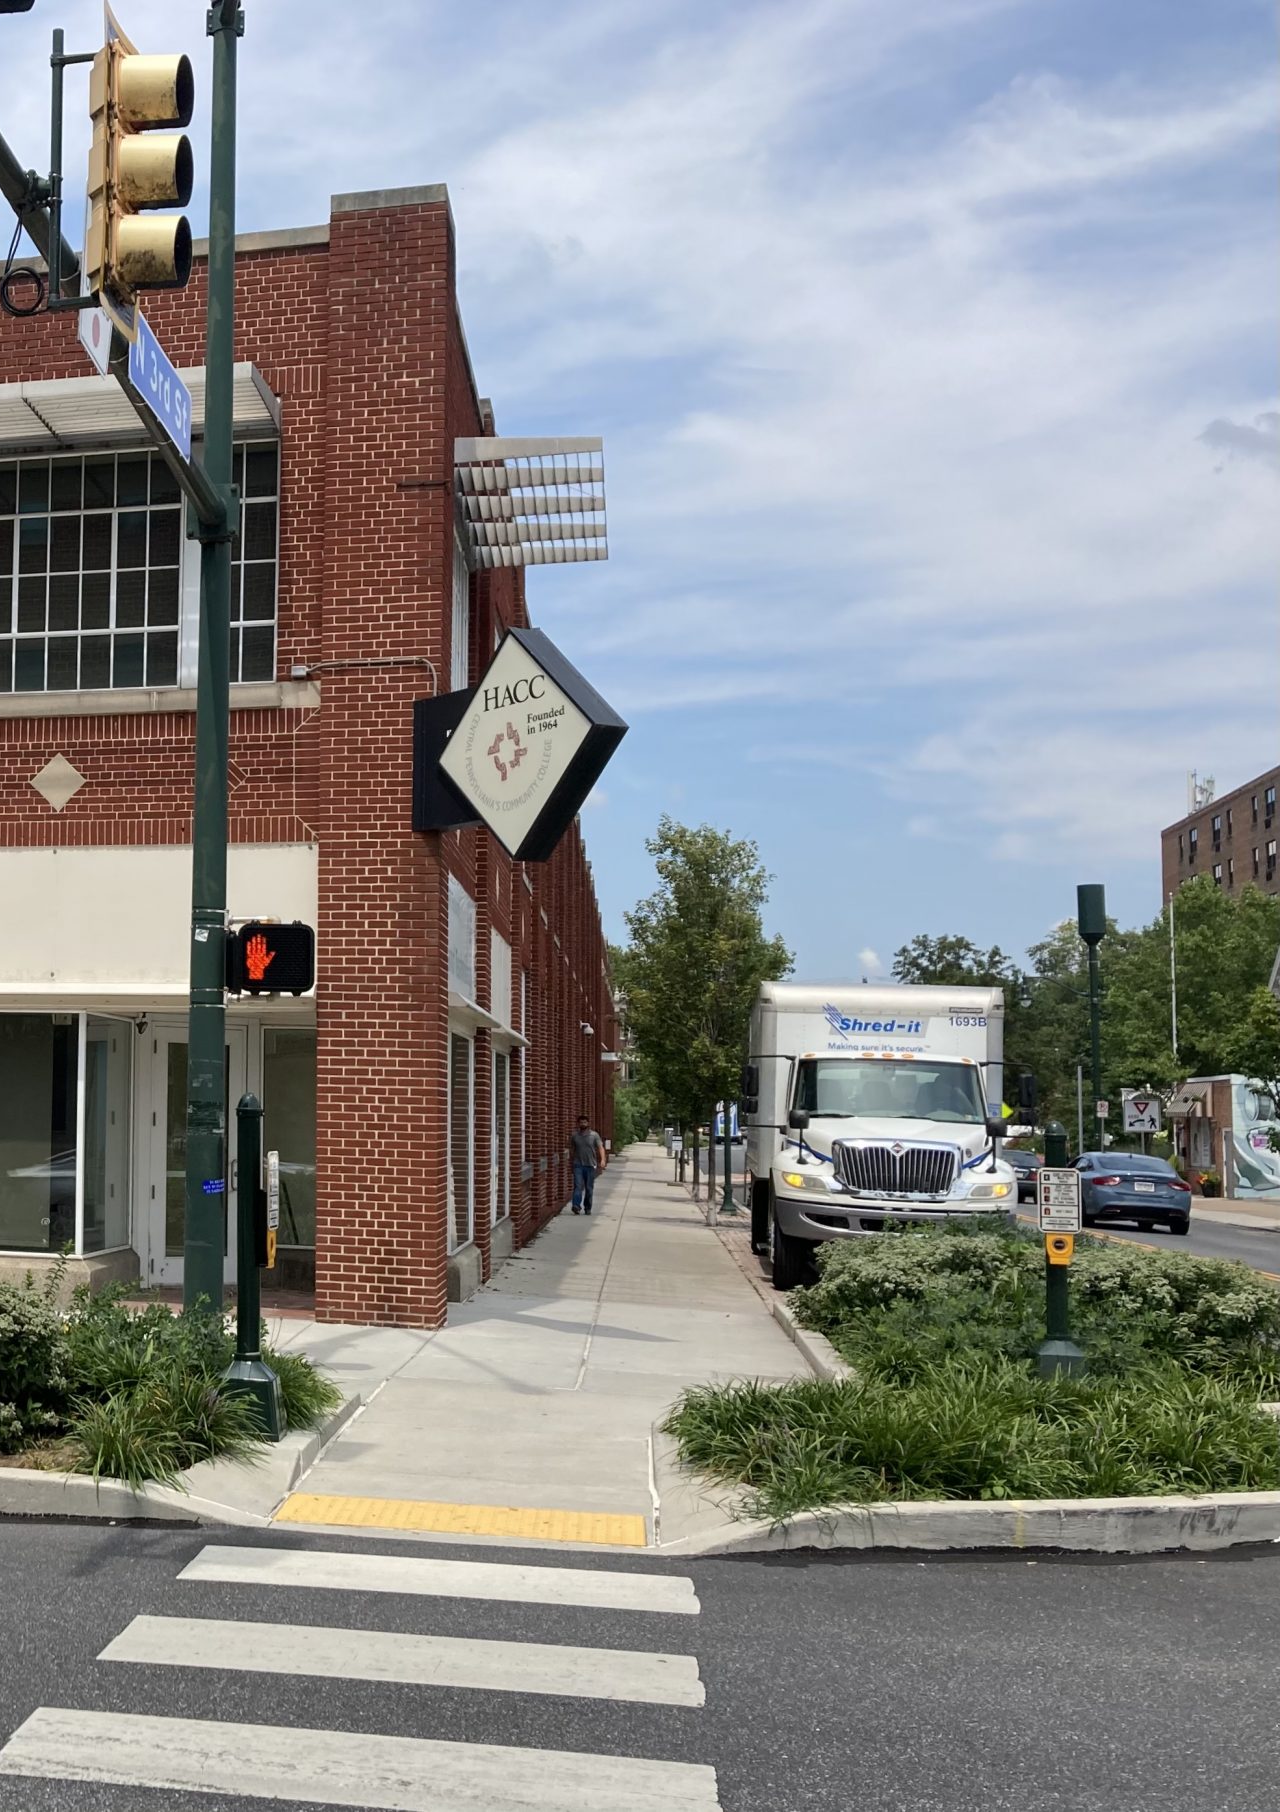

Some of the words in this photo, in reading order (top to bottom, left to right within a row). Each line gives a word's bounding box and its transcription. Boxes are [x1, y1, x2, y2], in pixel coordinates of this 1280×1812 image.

[135, 327, 146, 376] N
[150, 350, 171, 414] 3rd
[174, 388, 188, 439] St
[482, 674, 546, 712] HACC
[526, 705, 566, 724] Founded
[527, 724, 536, 735] in
[538, 719, 558, 733] 1964
[465, 713, 481, 753] CENTRAL
[537, 738, 552, 782] COLLEGE
[465, 756, 501, 811] PENNSYLVANIA'S
[502, 781, 538, 811] COMMUNITY
[839, 1018, 922, 1034] Shred-it
[948, 1016, 987, 1027] 1693B
[827, 1042, 858, 1051] Making
[881, 1043, 894, 1051] it's
